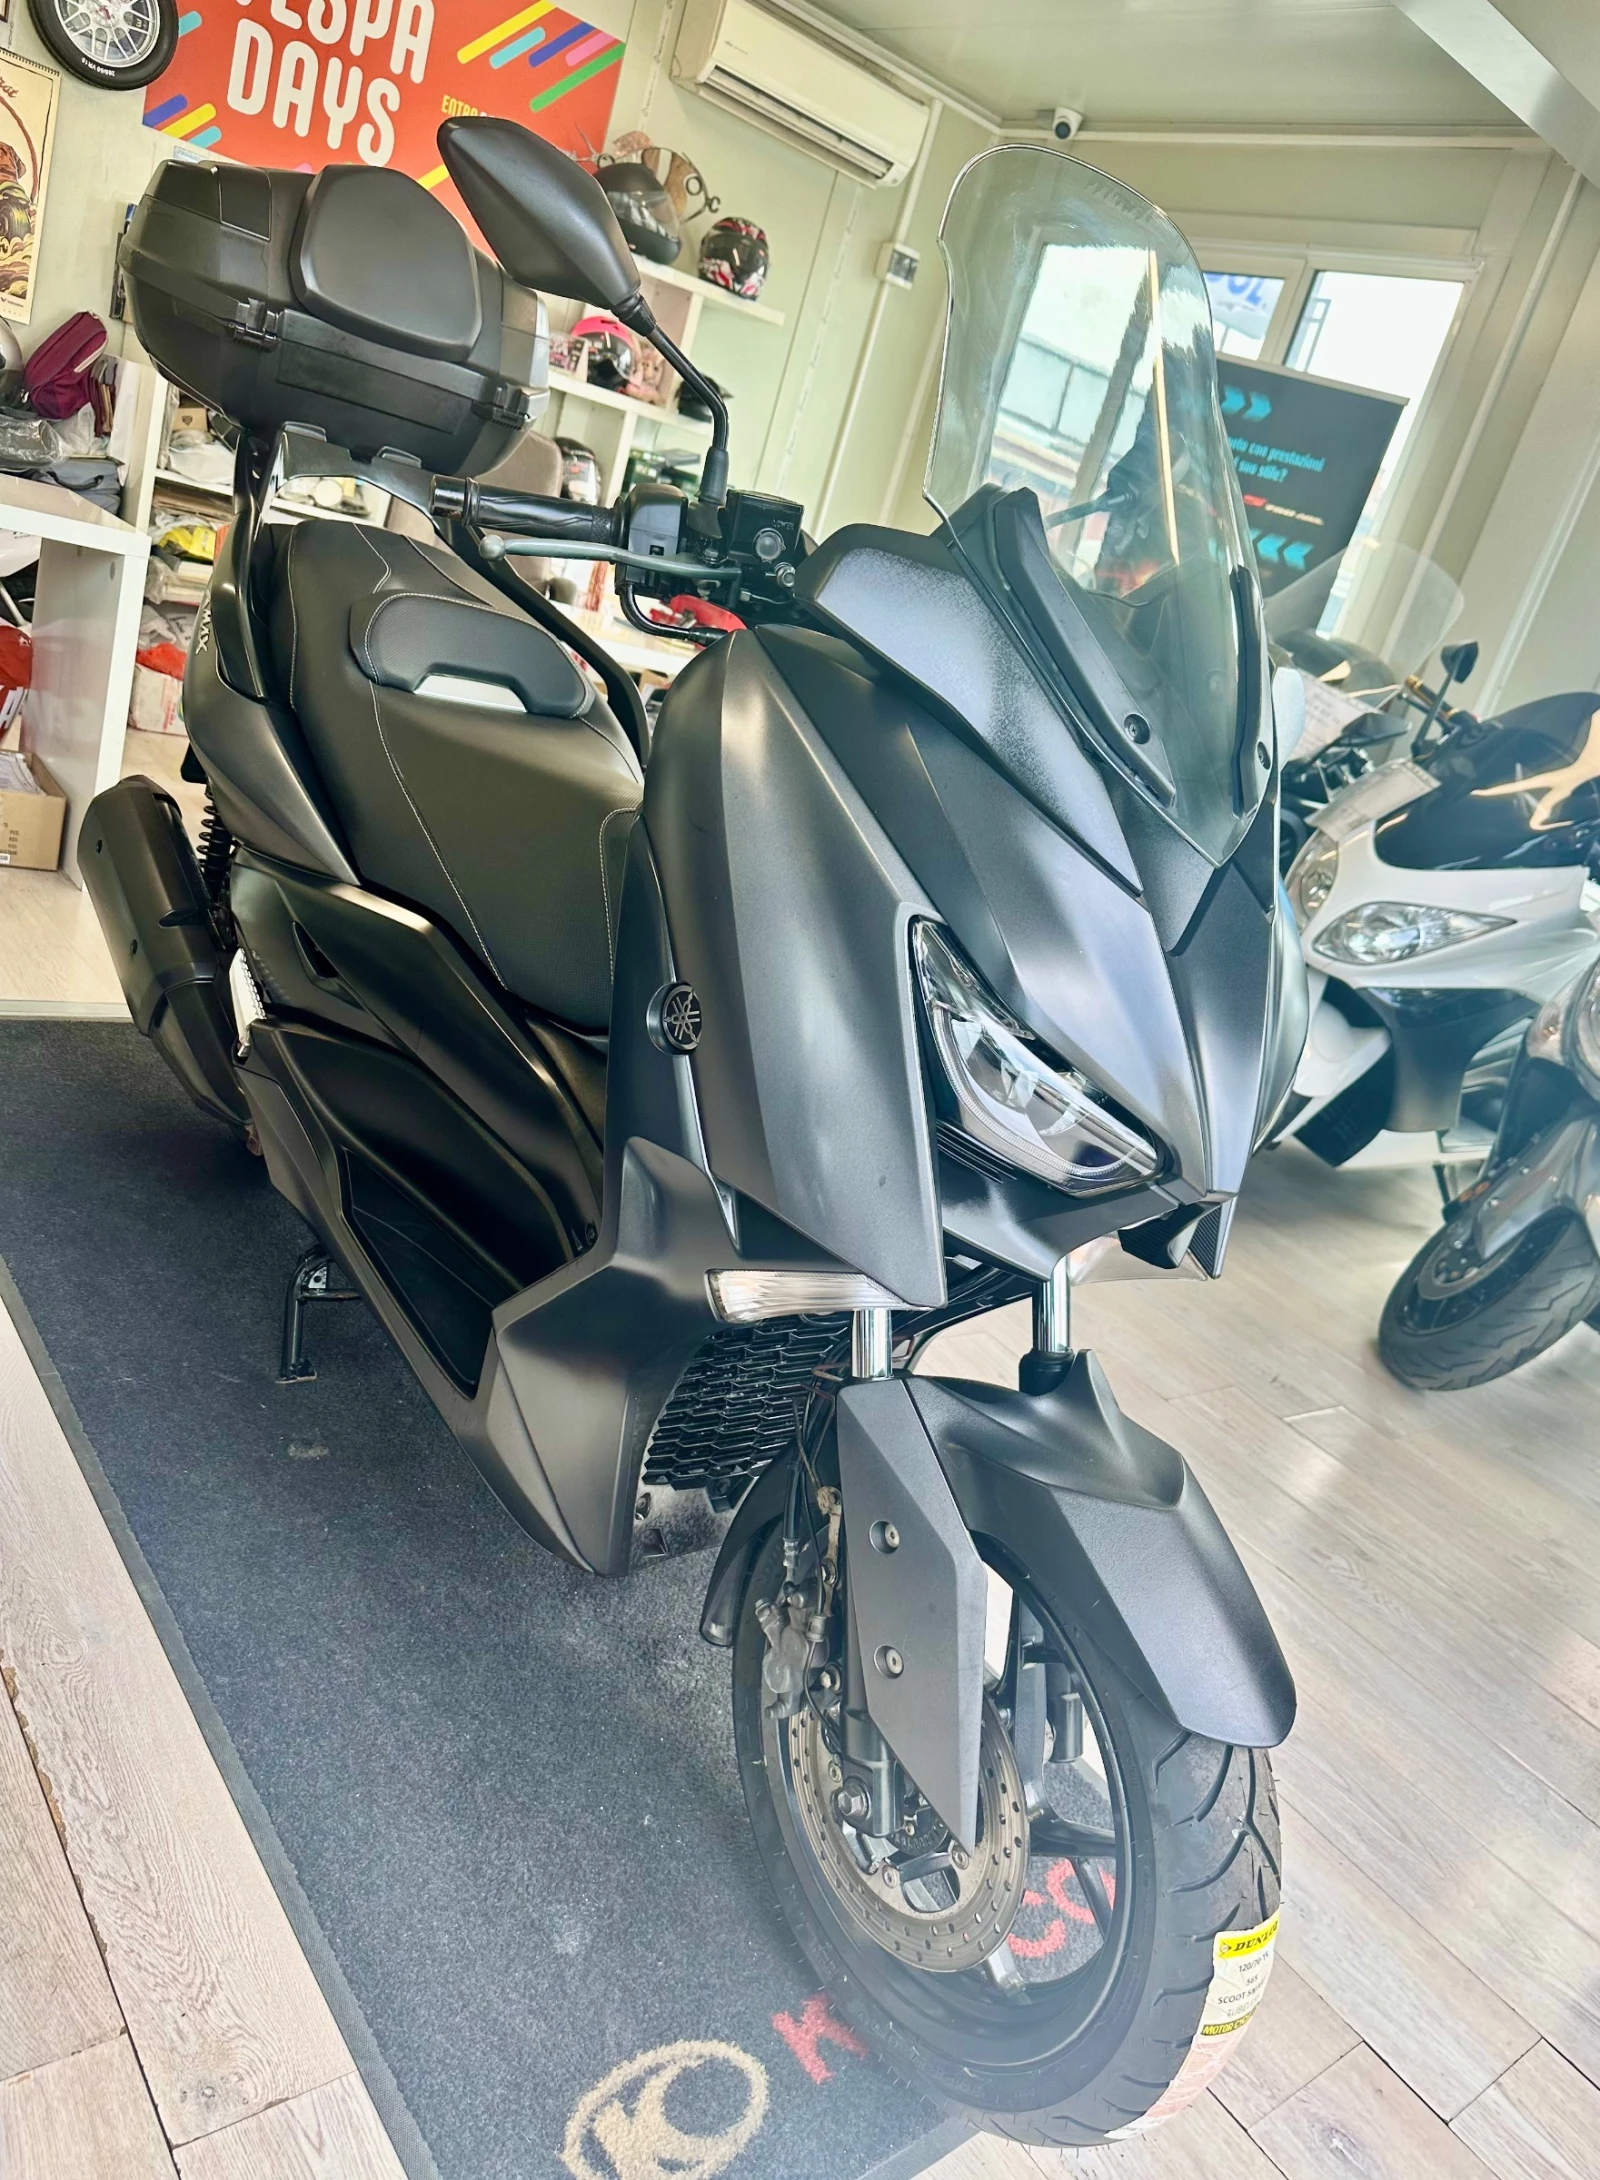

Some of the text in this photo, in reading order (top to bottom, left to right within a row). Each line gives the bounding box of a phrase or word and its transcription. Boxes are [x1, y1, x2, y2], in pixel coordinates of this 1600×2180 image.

[227, 18, 400, 167] DAYS
[1217, 1991, 1246, 2005] SCOOT
[1202, 2022, 1234, 2036] MOTOR
